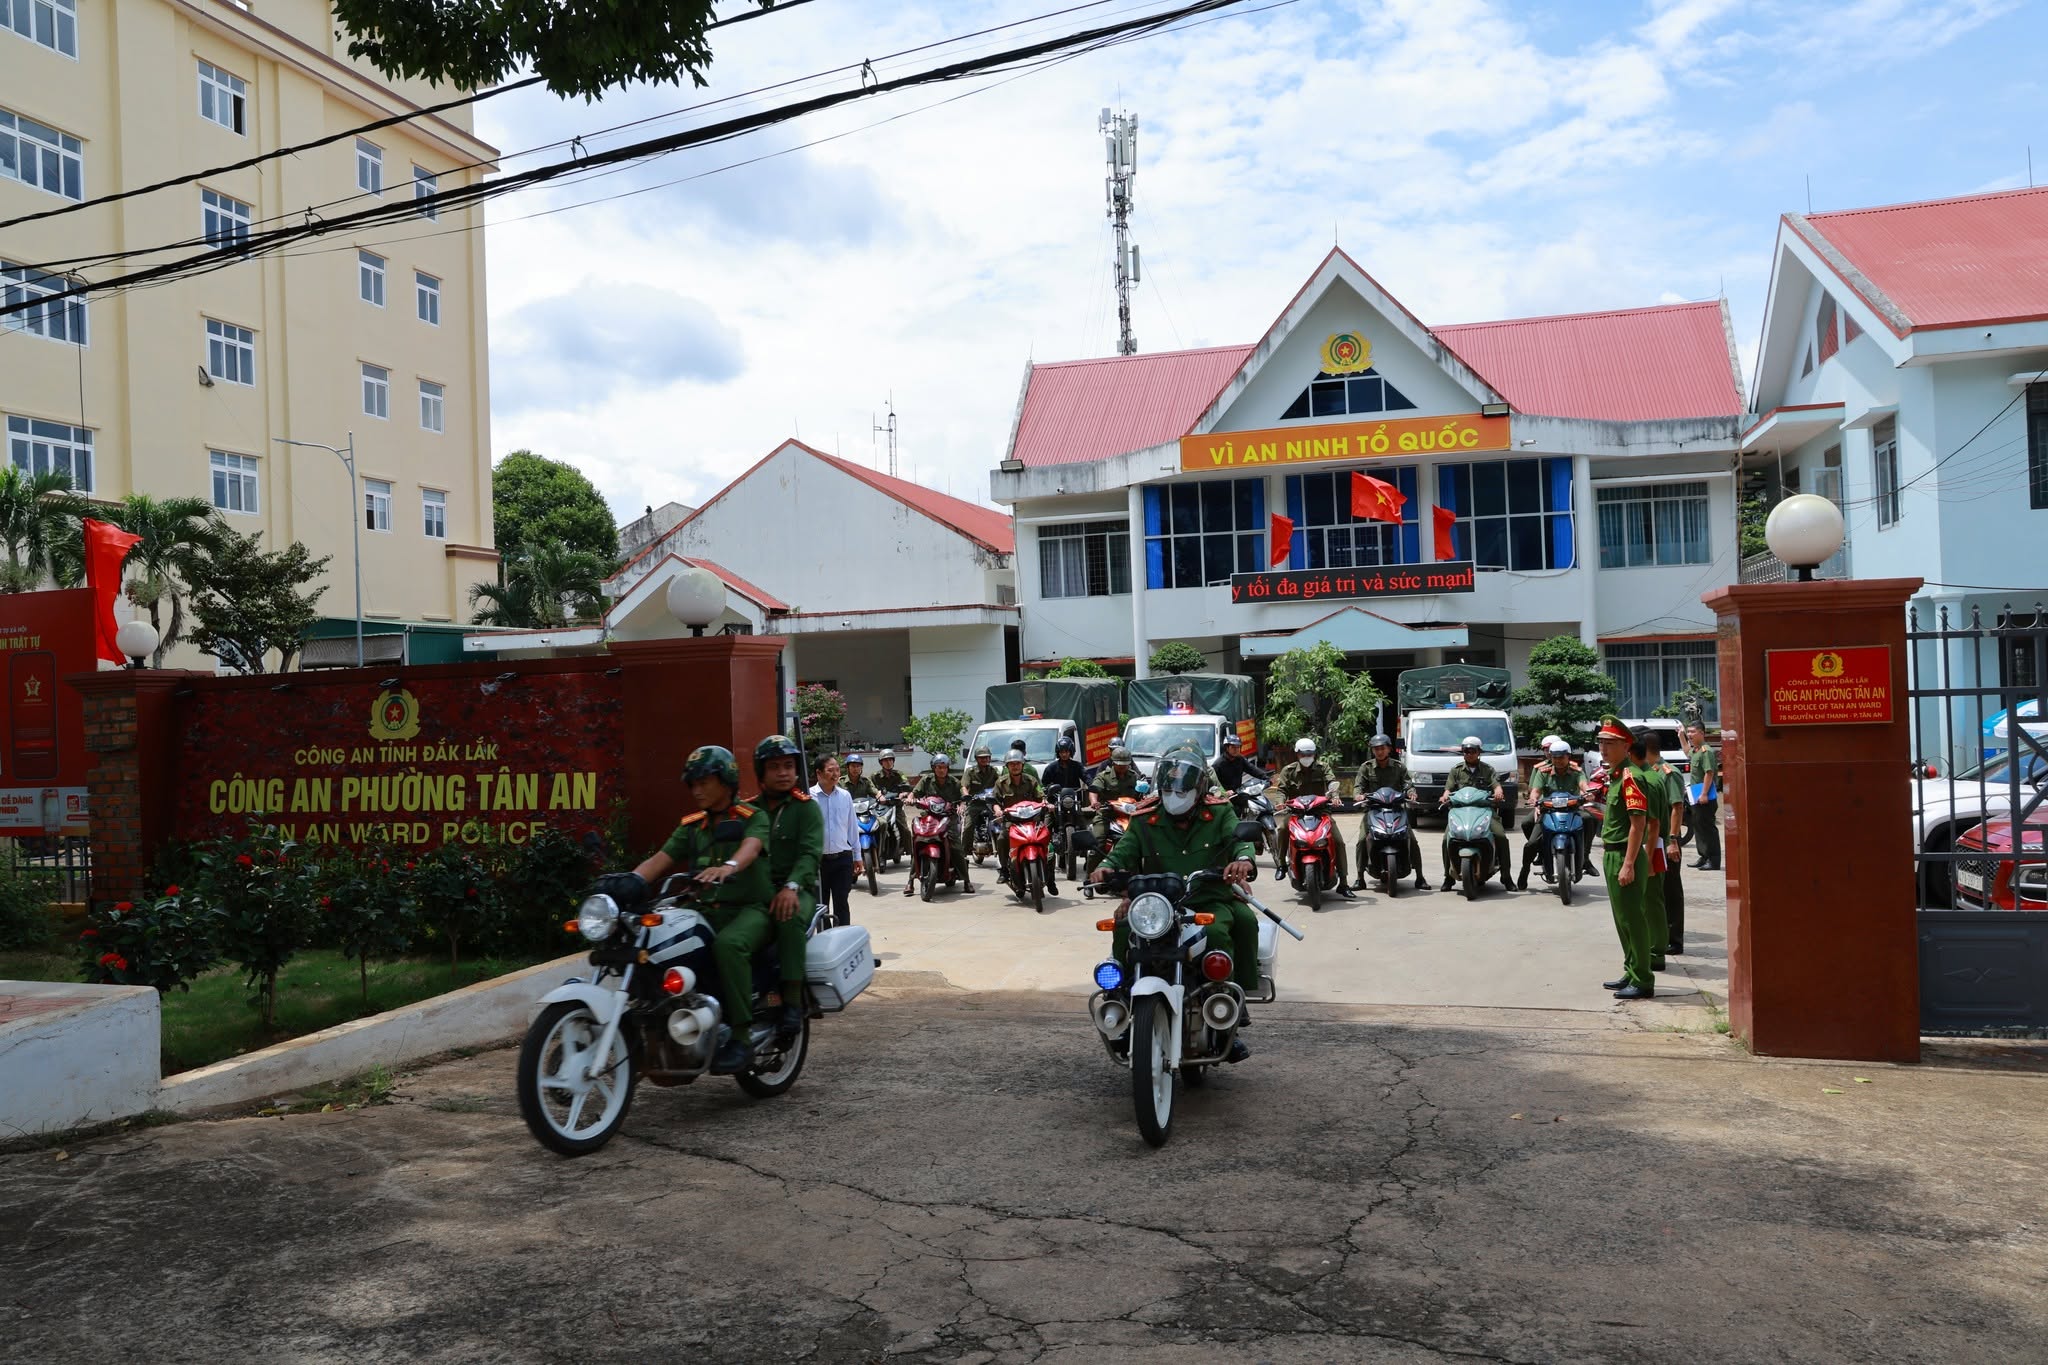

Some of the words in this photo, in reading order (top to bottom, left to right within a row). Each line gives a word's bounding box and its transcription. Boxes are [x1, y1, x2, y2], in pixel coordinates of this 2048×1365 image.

[1209, 441, 1234, 465] VÌ
[1242, 443, 1277, 463] AN
[1286, 437, 1348, 460] NINH
[1357, 424, 1390, 454] TỔ
[1399, 421, 1479, 451] QUỐC
[1248, 575, 1270, 597] tối
[1277, 578, 1299, 595] đa
[1303, 575, 1331, 598] giá
[1336, 573, 1356, 594] trị
[1362, 573, 1385, 591] và
[1389, 571, 1421, 590] sức
[1774, 686, 1798, 702] CÔNG
[1800, 689, 1812, 701] AN
[1814, 686, 1852, 701] PHƯỜNG
[1872, 687, 1885, 699] AN
[1793, 703, 1817, 711] POLICE
[1859, 701, 1882, 709] WARD
[295, 745, 345, 765] CÔNG
[351, 747, 374, 763] AN
[380, 740, 417, 763] TỈNH
[423, 737, 459, 762] ĐẮK
[465, 736, 499, 761] LẮK
[210, 772, 284, 814] CÔNG
[290, 778, 331, 812] AN
[341, 767, 466, 812] PHƯỜNG
[476, 766, 539, 810] TÂN
[549, 772, 596, 810] AN
[305, 823, 340, 844] AN
